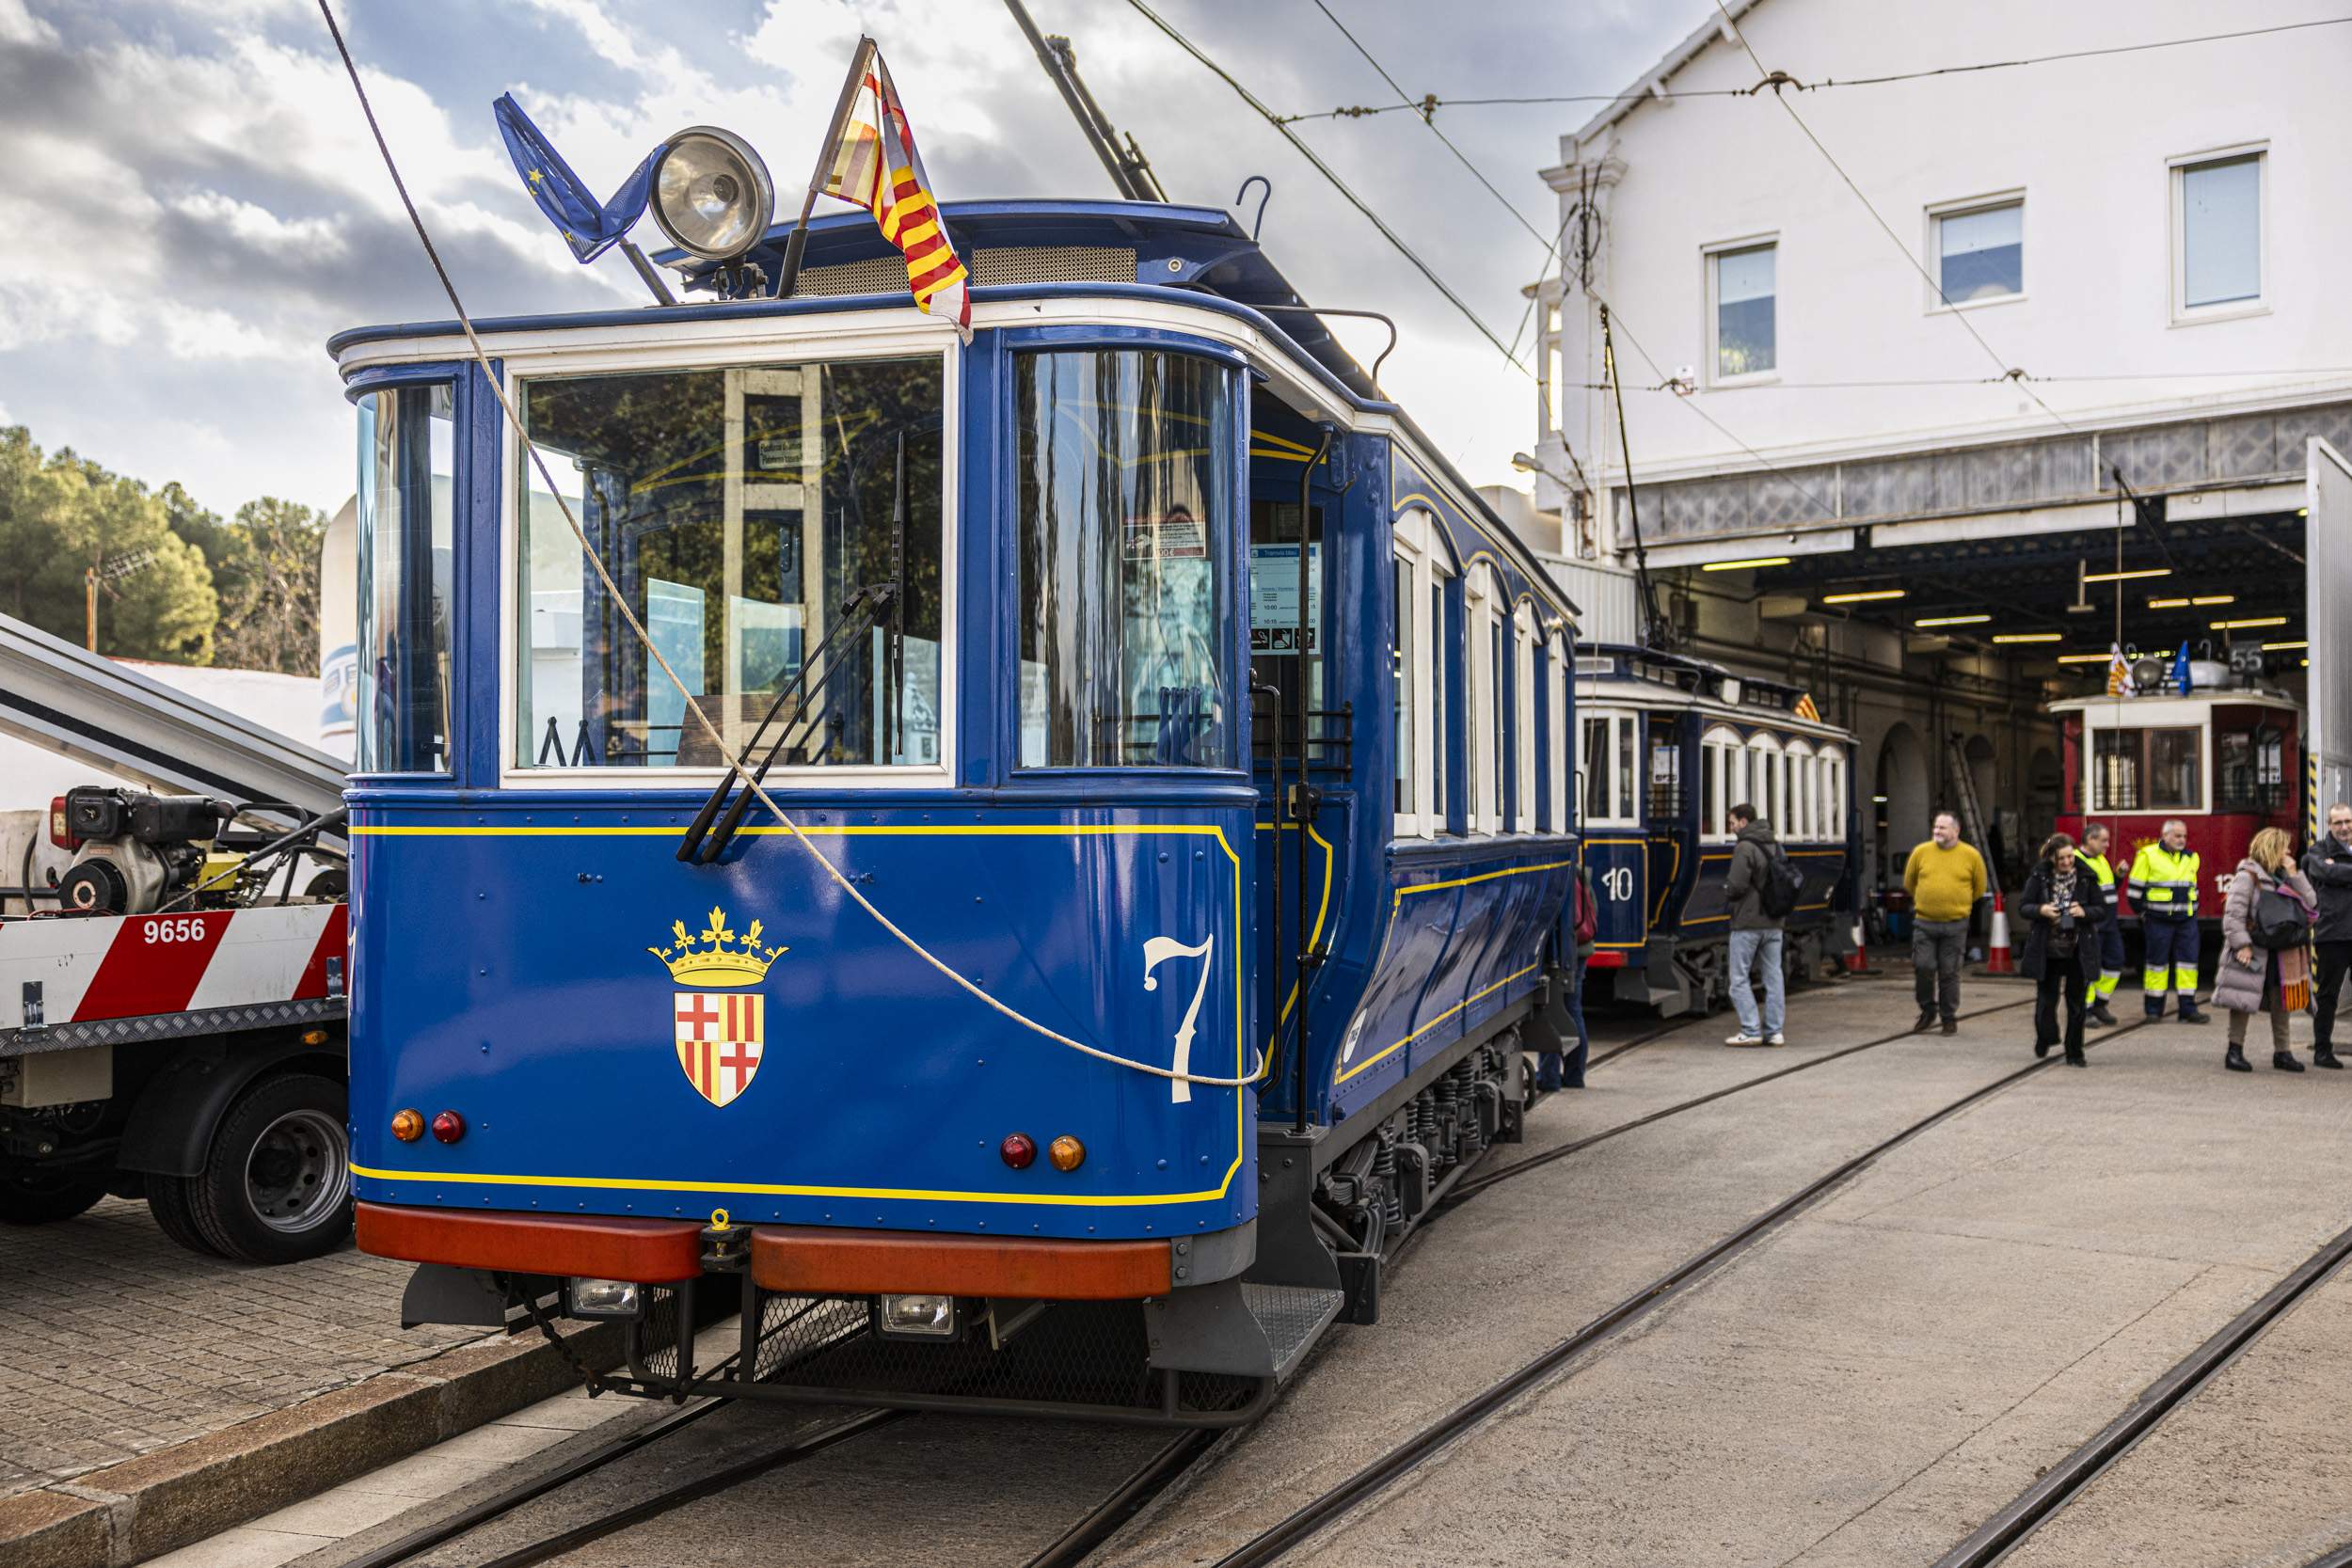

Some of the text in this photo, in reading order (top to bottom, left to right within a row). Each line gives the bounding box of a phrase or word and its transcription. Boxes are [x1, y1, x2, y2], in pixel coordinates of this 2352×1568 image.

[1601, 867, 1633, 901] 10
[143, 918, 205, 944] 9656
[1142, 932, 1214, 1104] 7
